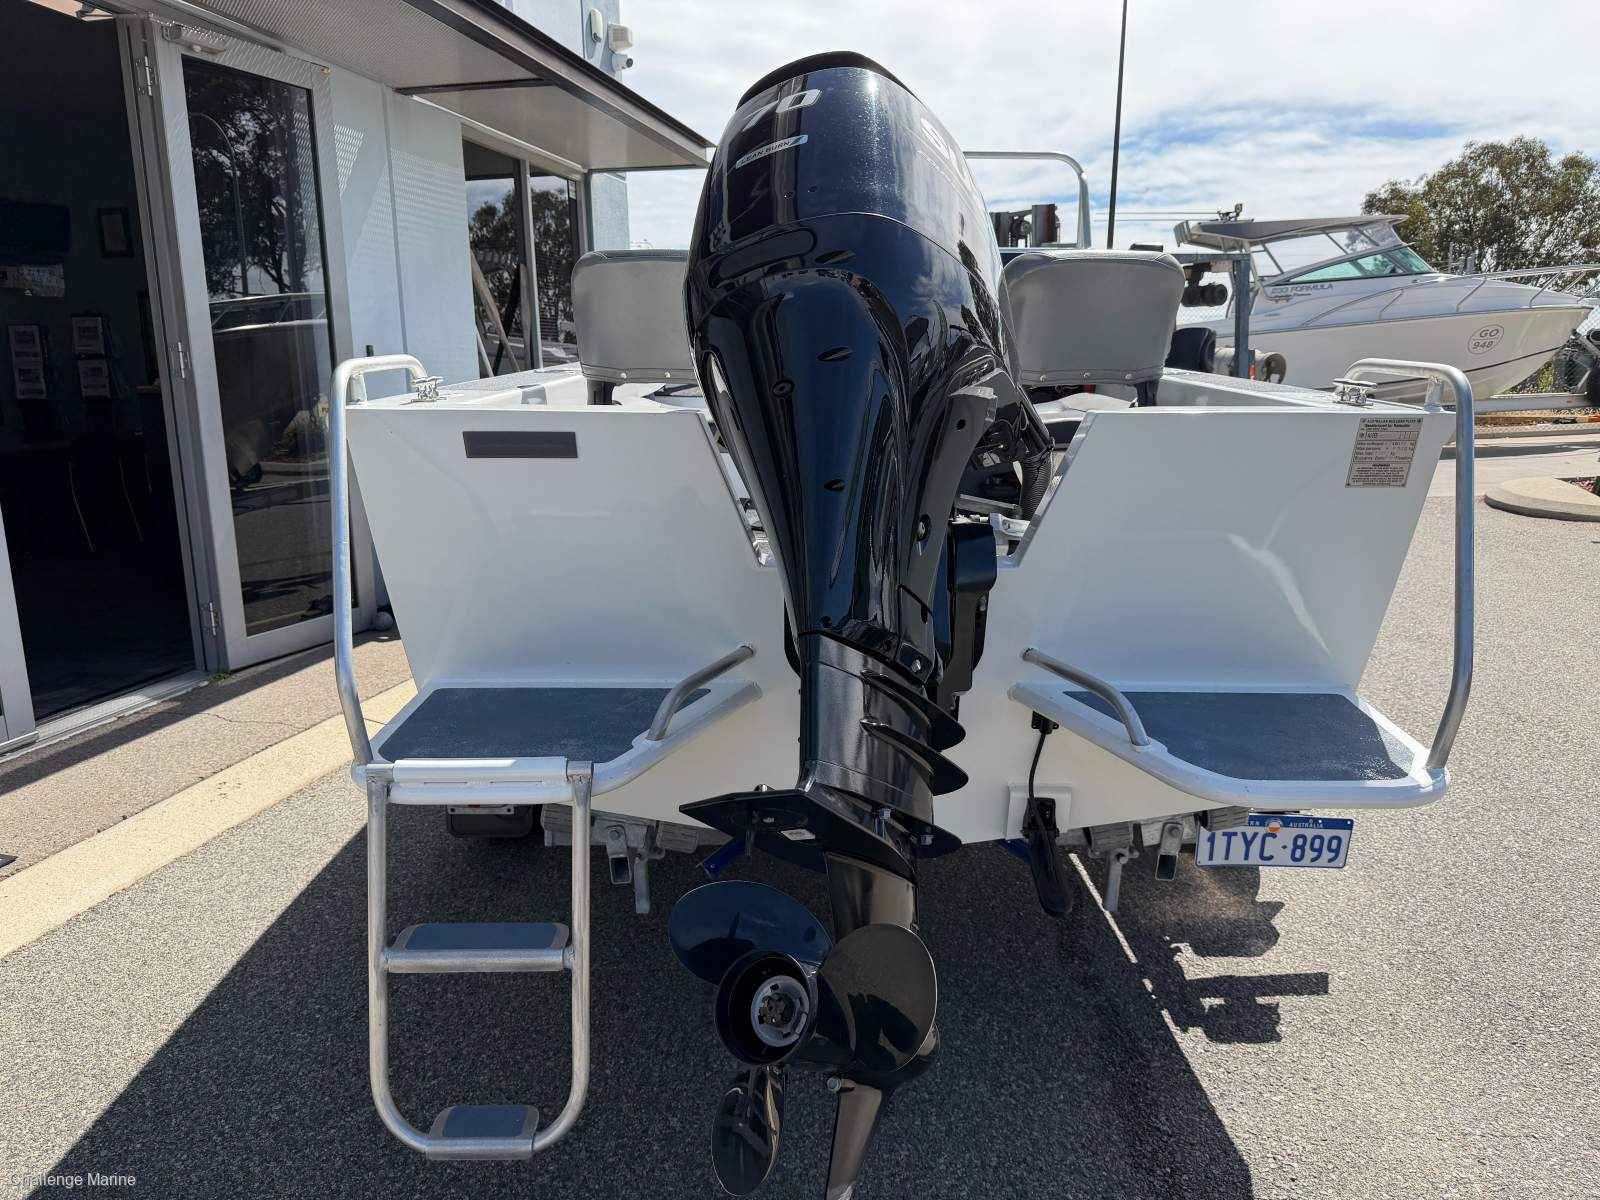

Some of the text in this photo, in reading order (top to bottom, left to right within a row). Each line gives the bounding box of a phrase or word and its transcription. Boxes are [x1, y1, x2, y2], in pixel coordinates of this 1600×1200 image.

[742, 89, 821, 132] 70
[1290, 283, 1334, 293] FORMULA
[1480, 329, 1499, 338] GO
[1472, 340, 1493, 350] 948
[1288, 821, 1324, 829] AUSTRALIA
